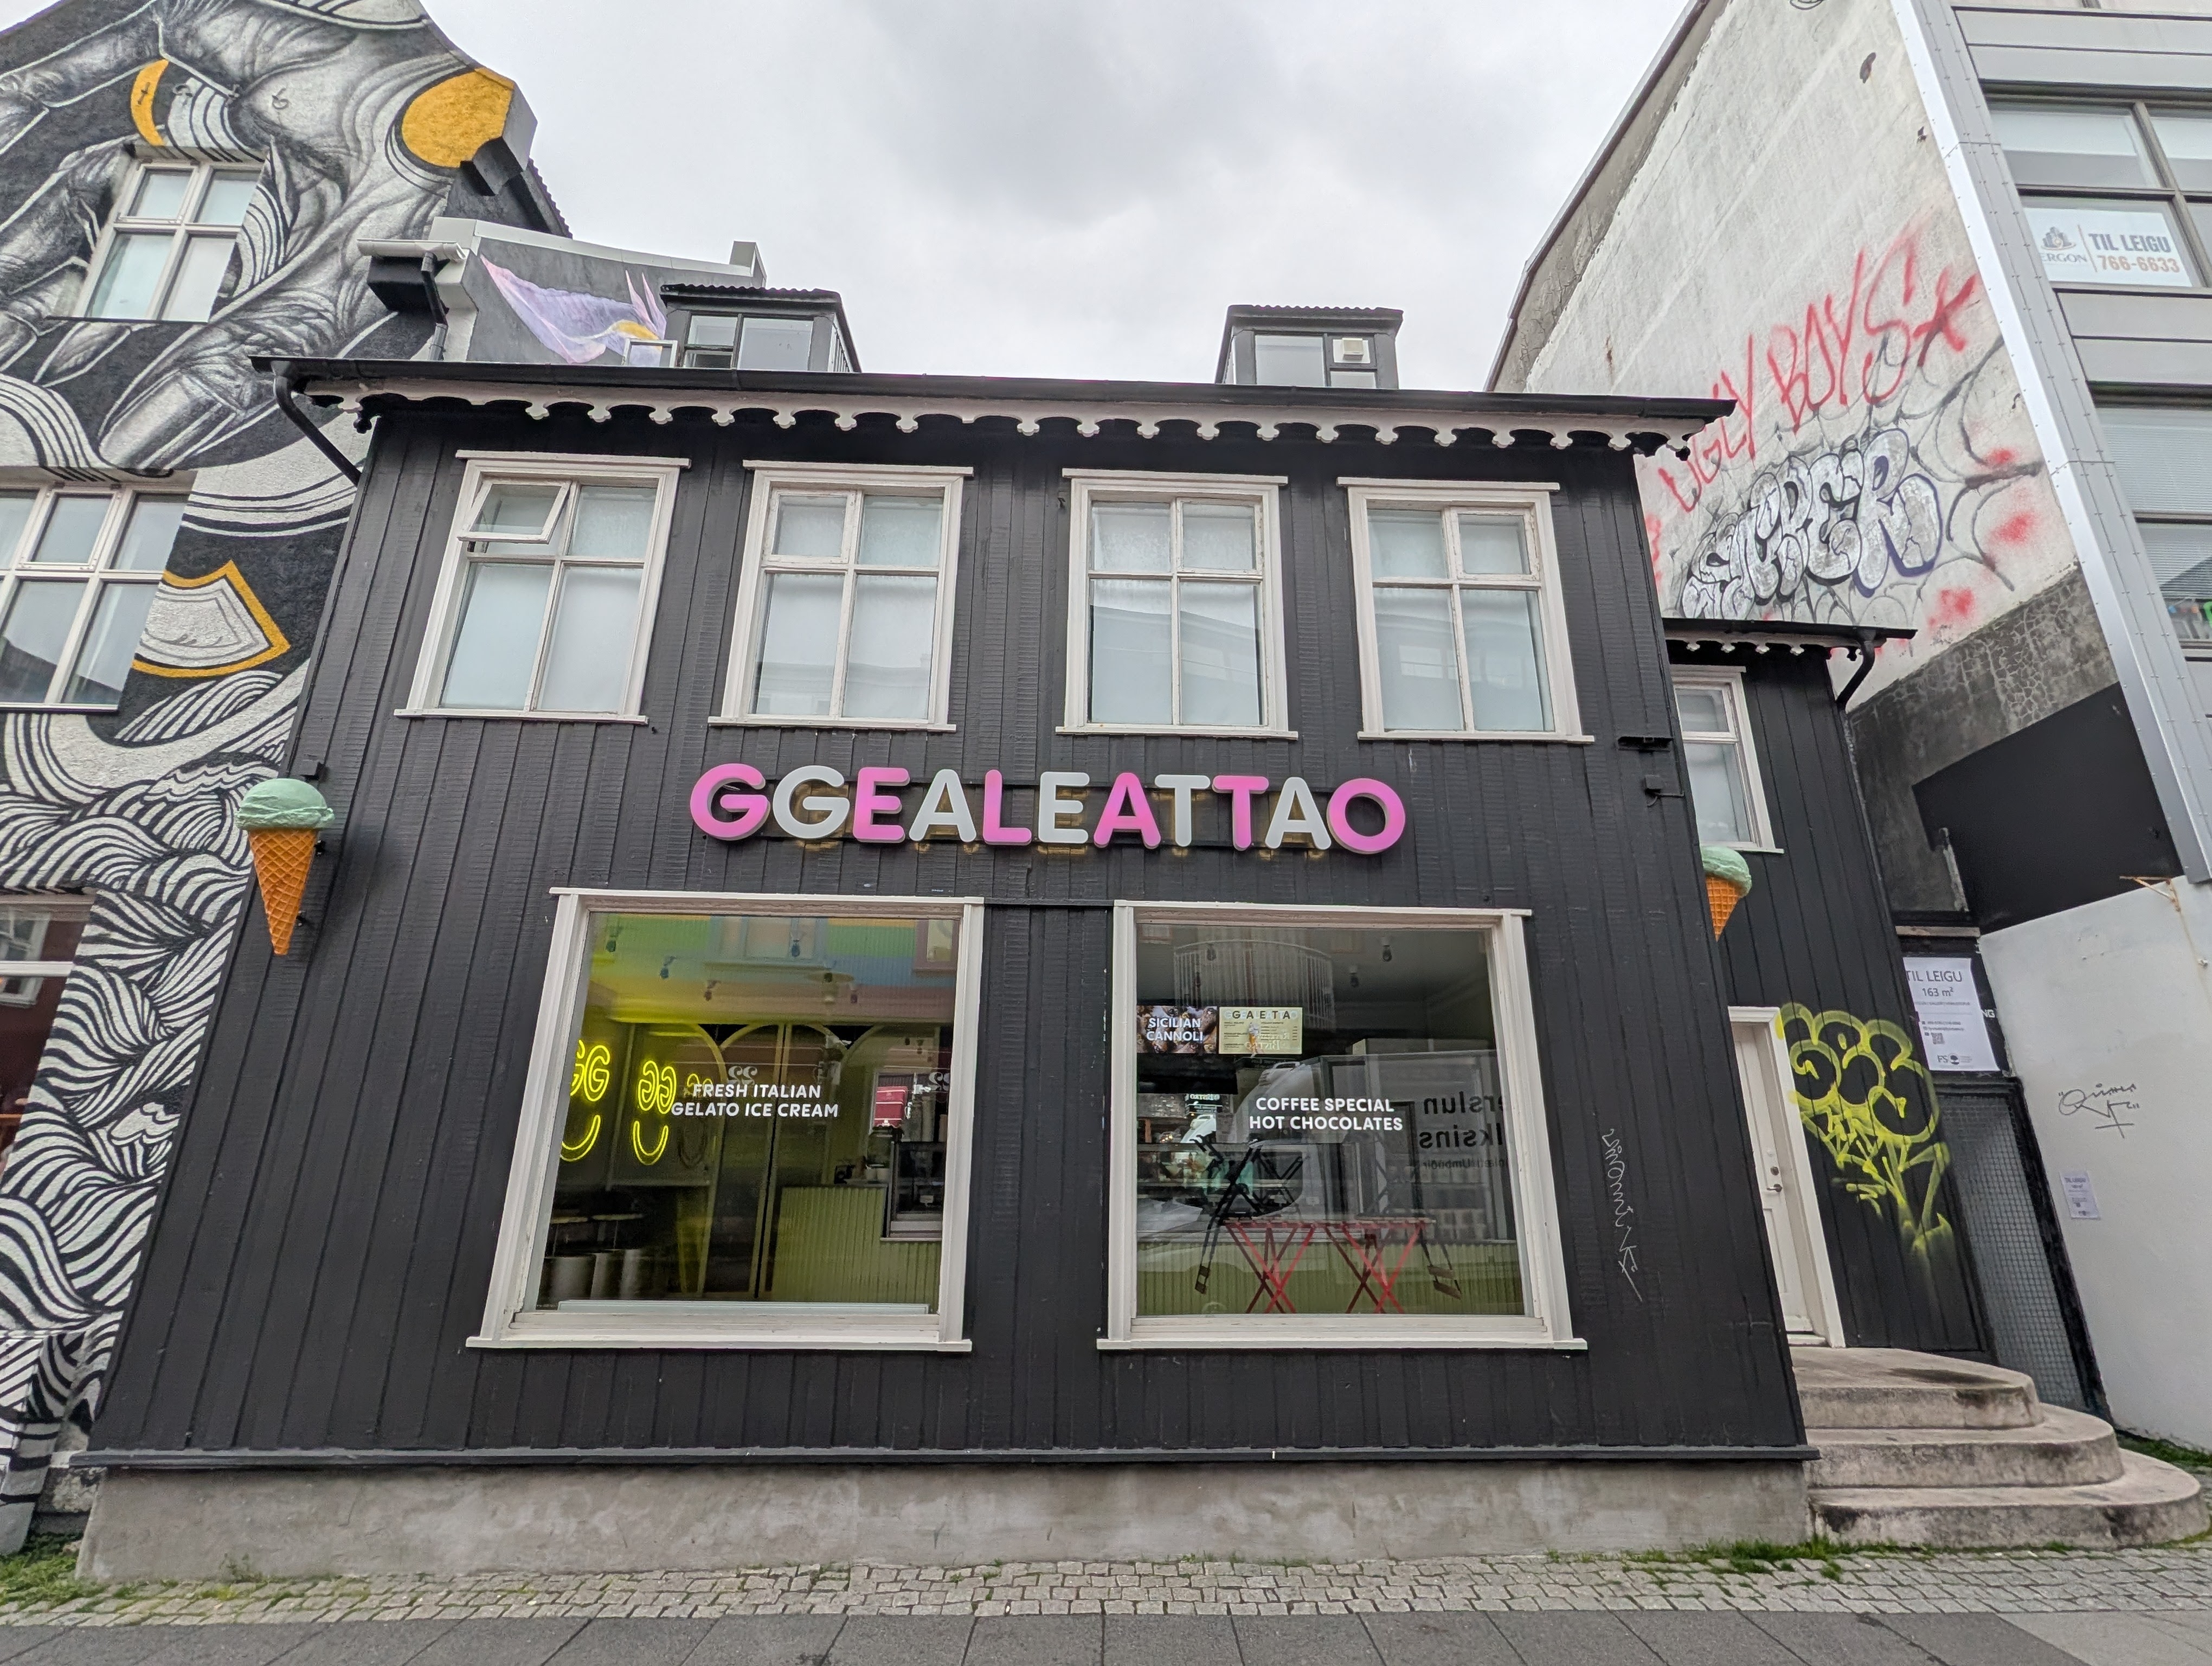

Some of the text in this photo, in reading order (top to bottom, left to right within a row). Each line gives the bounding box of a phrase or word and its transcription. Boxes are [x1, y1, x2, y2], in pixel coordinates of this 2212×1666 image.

[2088, 233, 2171, 253] TIL LEIGU
[2097, 254, 2180, 273] 766-6633
[1906, 970, 1963, 982] TIL LEIGU
[1922, 987, 1939, 997] 163
[1148, 1017, 1201, 1028] SICILIAN
[1146, 1031, 1204, 1042] CANNOLI
[693, 1084, 748, 1098] FRESH
[754, 1084, 821, 1098] ITALIAN
[671, 1102, 838, 1118] GELATO ICE CREAM
[1256, 1098, 1394, 1112] COFFEE SPECIAL
[1250, 1116, 1403, 1131] HOT CHOCOLATES
